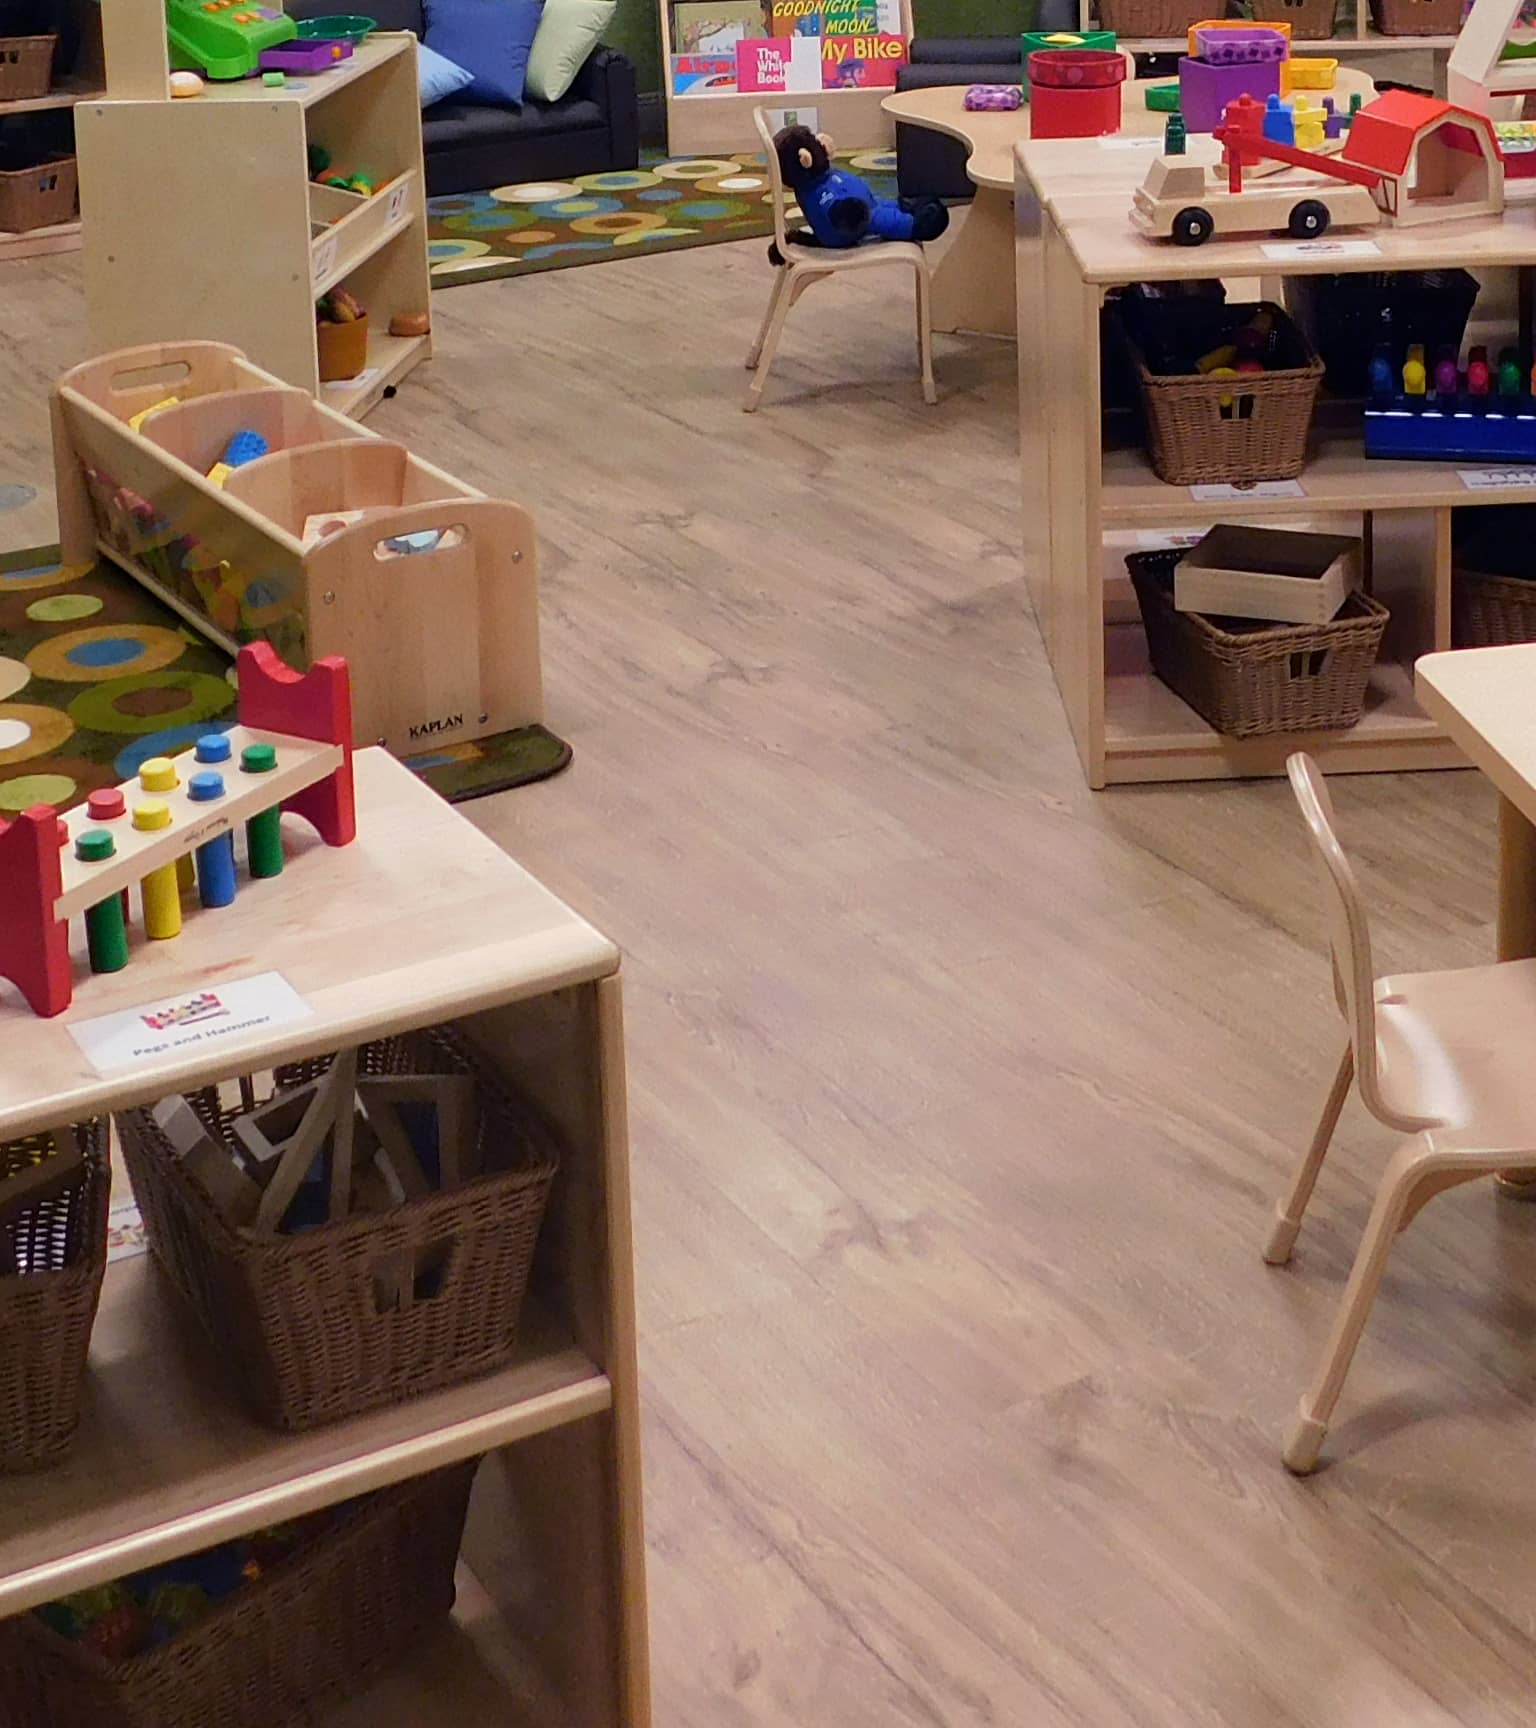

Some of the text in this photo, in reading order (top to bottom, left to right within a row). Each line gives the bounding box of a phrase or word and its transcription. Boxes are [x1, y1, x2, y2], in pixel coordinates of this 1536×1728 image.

[825, 18, 872, 35] MOON
[756, 47, 781, 60] The
[853, 38, 903, 59] Bike
[677, 57, 737, 74] Airp
[408, 713, 464, 739] KAPLAN
[132, 1015, 271, 1057] Pegs and Hammer
